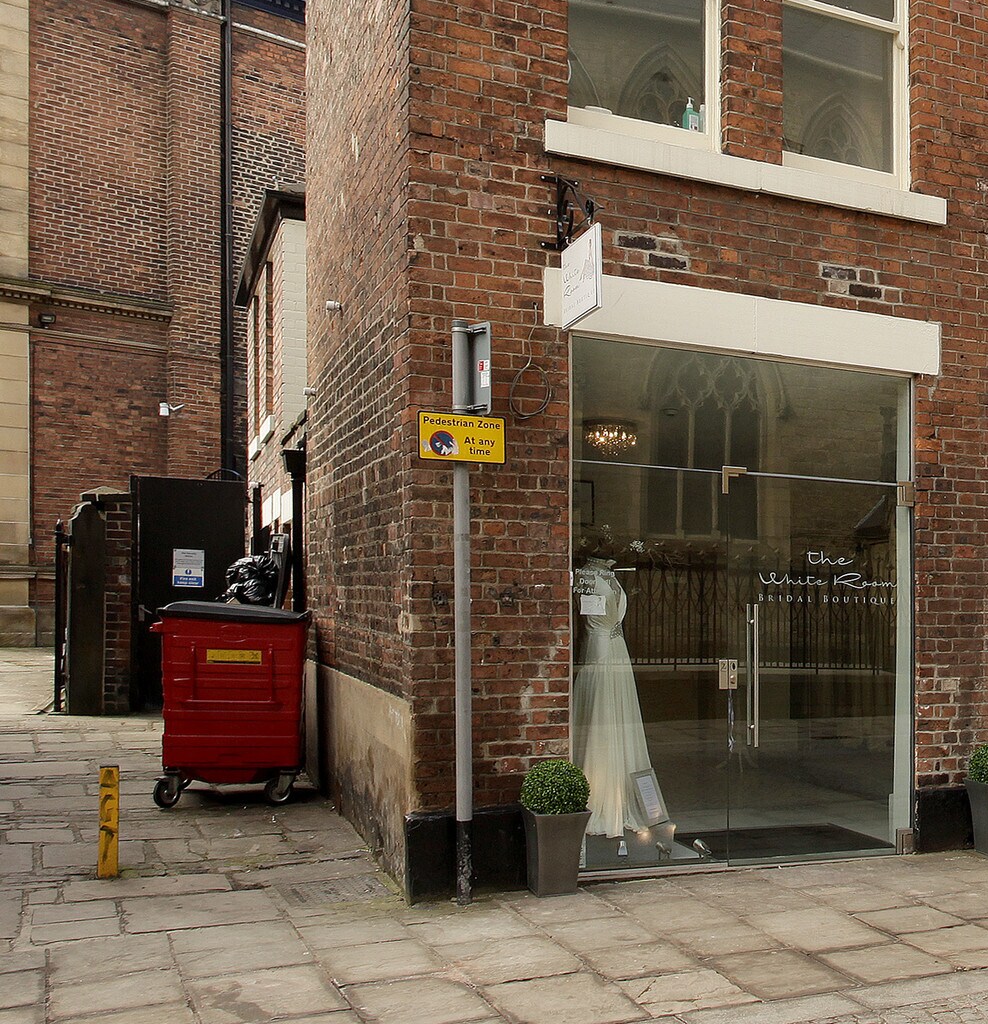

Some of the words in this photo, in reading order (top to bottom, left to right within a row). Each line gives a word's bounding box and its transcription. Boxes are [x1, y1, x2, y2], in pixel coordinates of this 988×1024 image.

[423, 416, 474, 428] Pedestrian
[478, 420, 500, 430] Zone
[464, 436, 476, 444] At
[478, 438, 496, 448] any
[469, 447, 490, 456] time
[807, 551, 854, 566] the
[758, 572, 828, 586] White
[834, 573, 897, 589] Room
[758, 594, 812, 603] BRIDAL
[823, 595, 895, 606] BOUTIQUE
